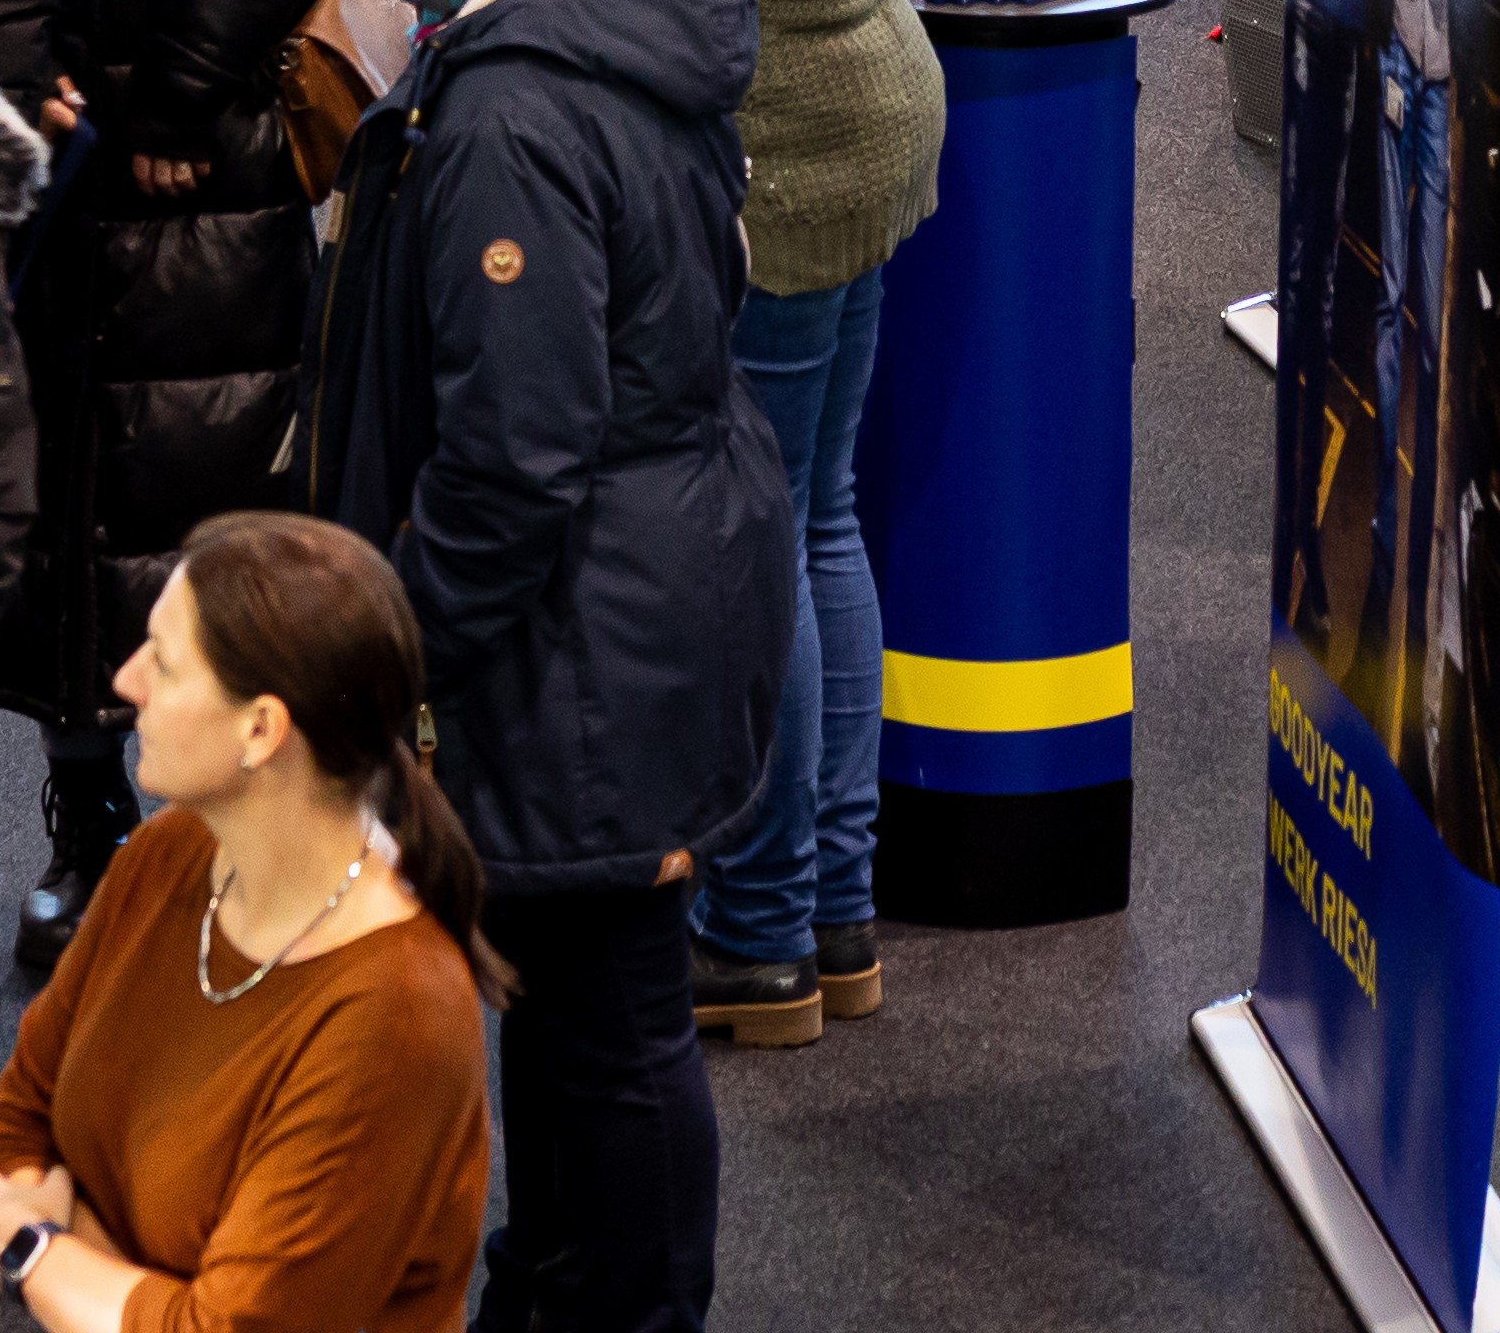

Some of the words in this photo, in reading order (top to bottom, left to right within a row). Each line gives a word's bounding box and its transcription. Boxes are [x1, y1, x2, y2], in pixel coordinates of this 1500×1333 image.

[1270, 668, 1373, 861] GOODYEAR
[1269, 789, 1318, 925] WERK
[1323, 872, 1377, 1010] RIESA
